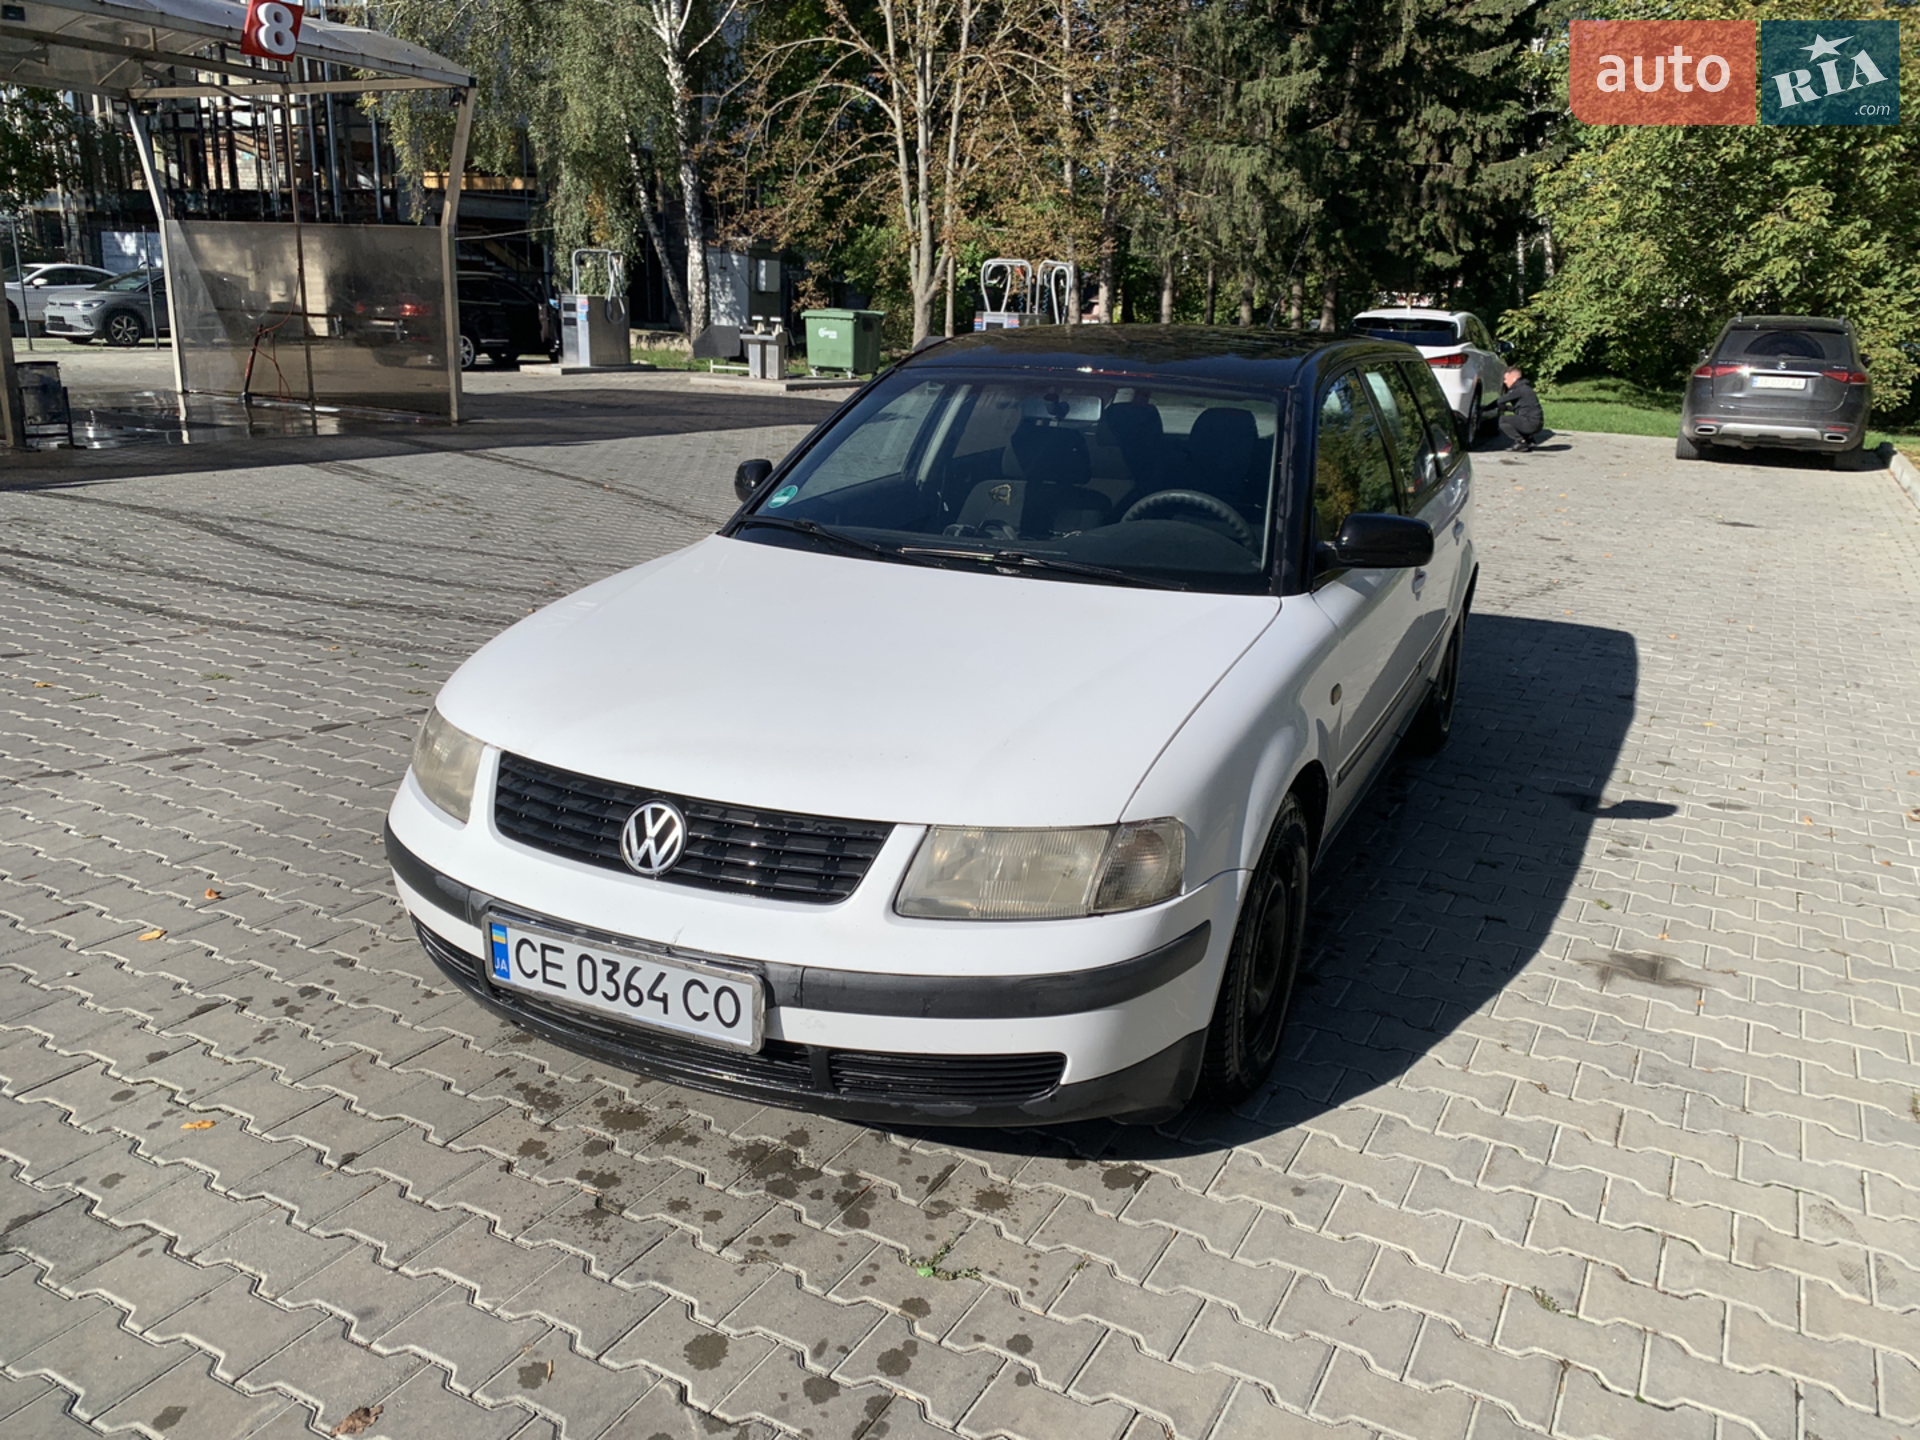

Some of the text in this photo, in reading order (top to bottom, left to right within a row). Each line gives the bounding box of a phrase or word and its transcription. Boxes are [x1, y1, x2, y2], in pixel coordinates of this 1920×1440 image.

[256, 2, 297, 56] 8
[621, 801, 685, 875] VW
[515, 937, 742, 1028] CE 0364 CO
